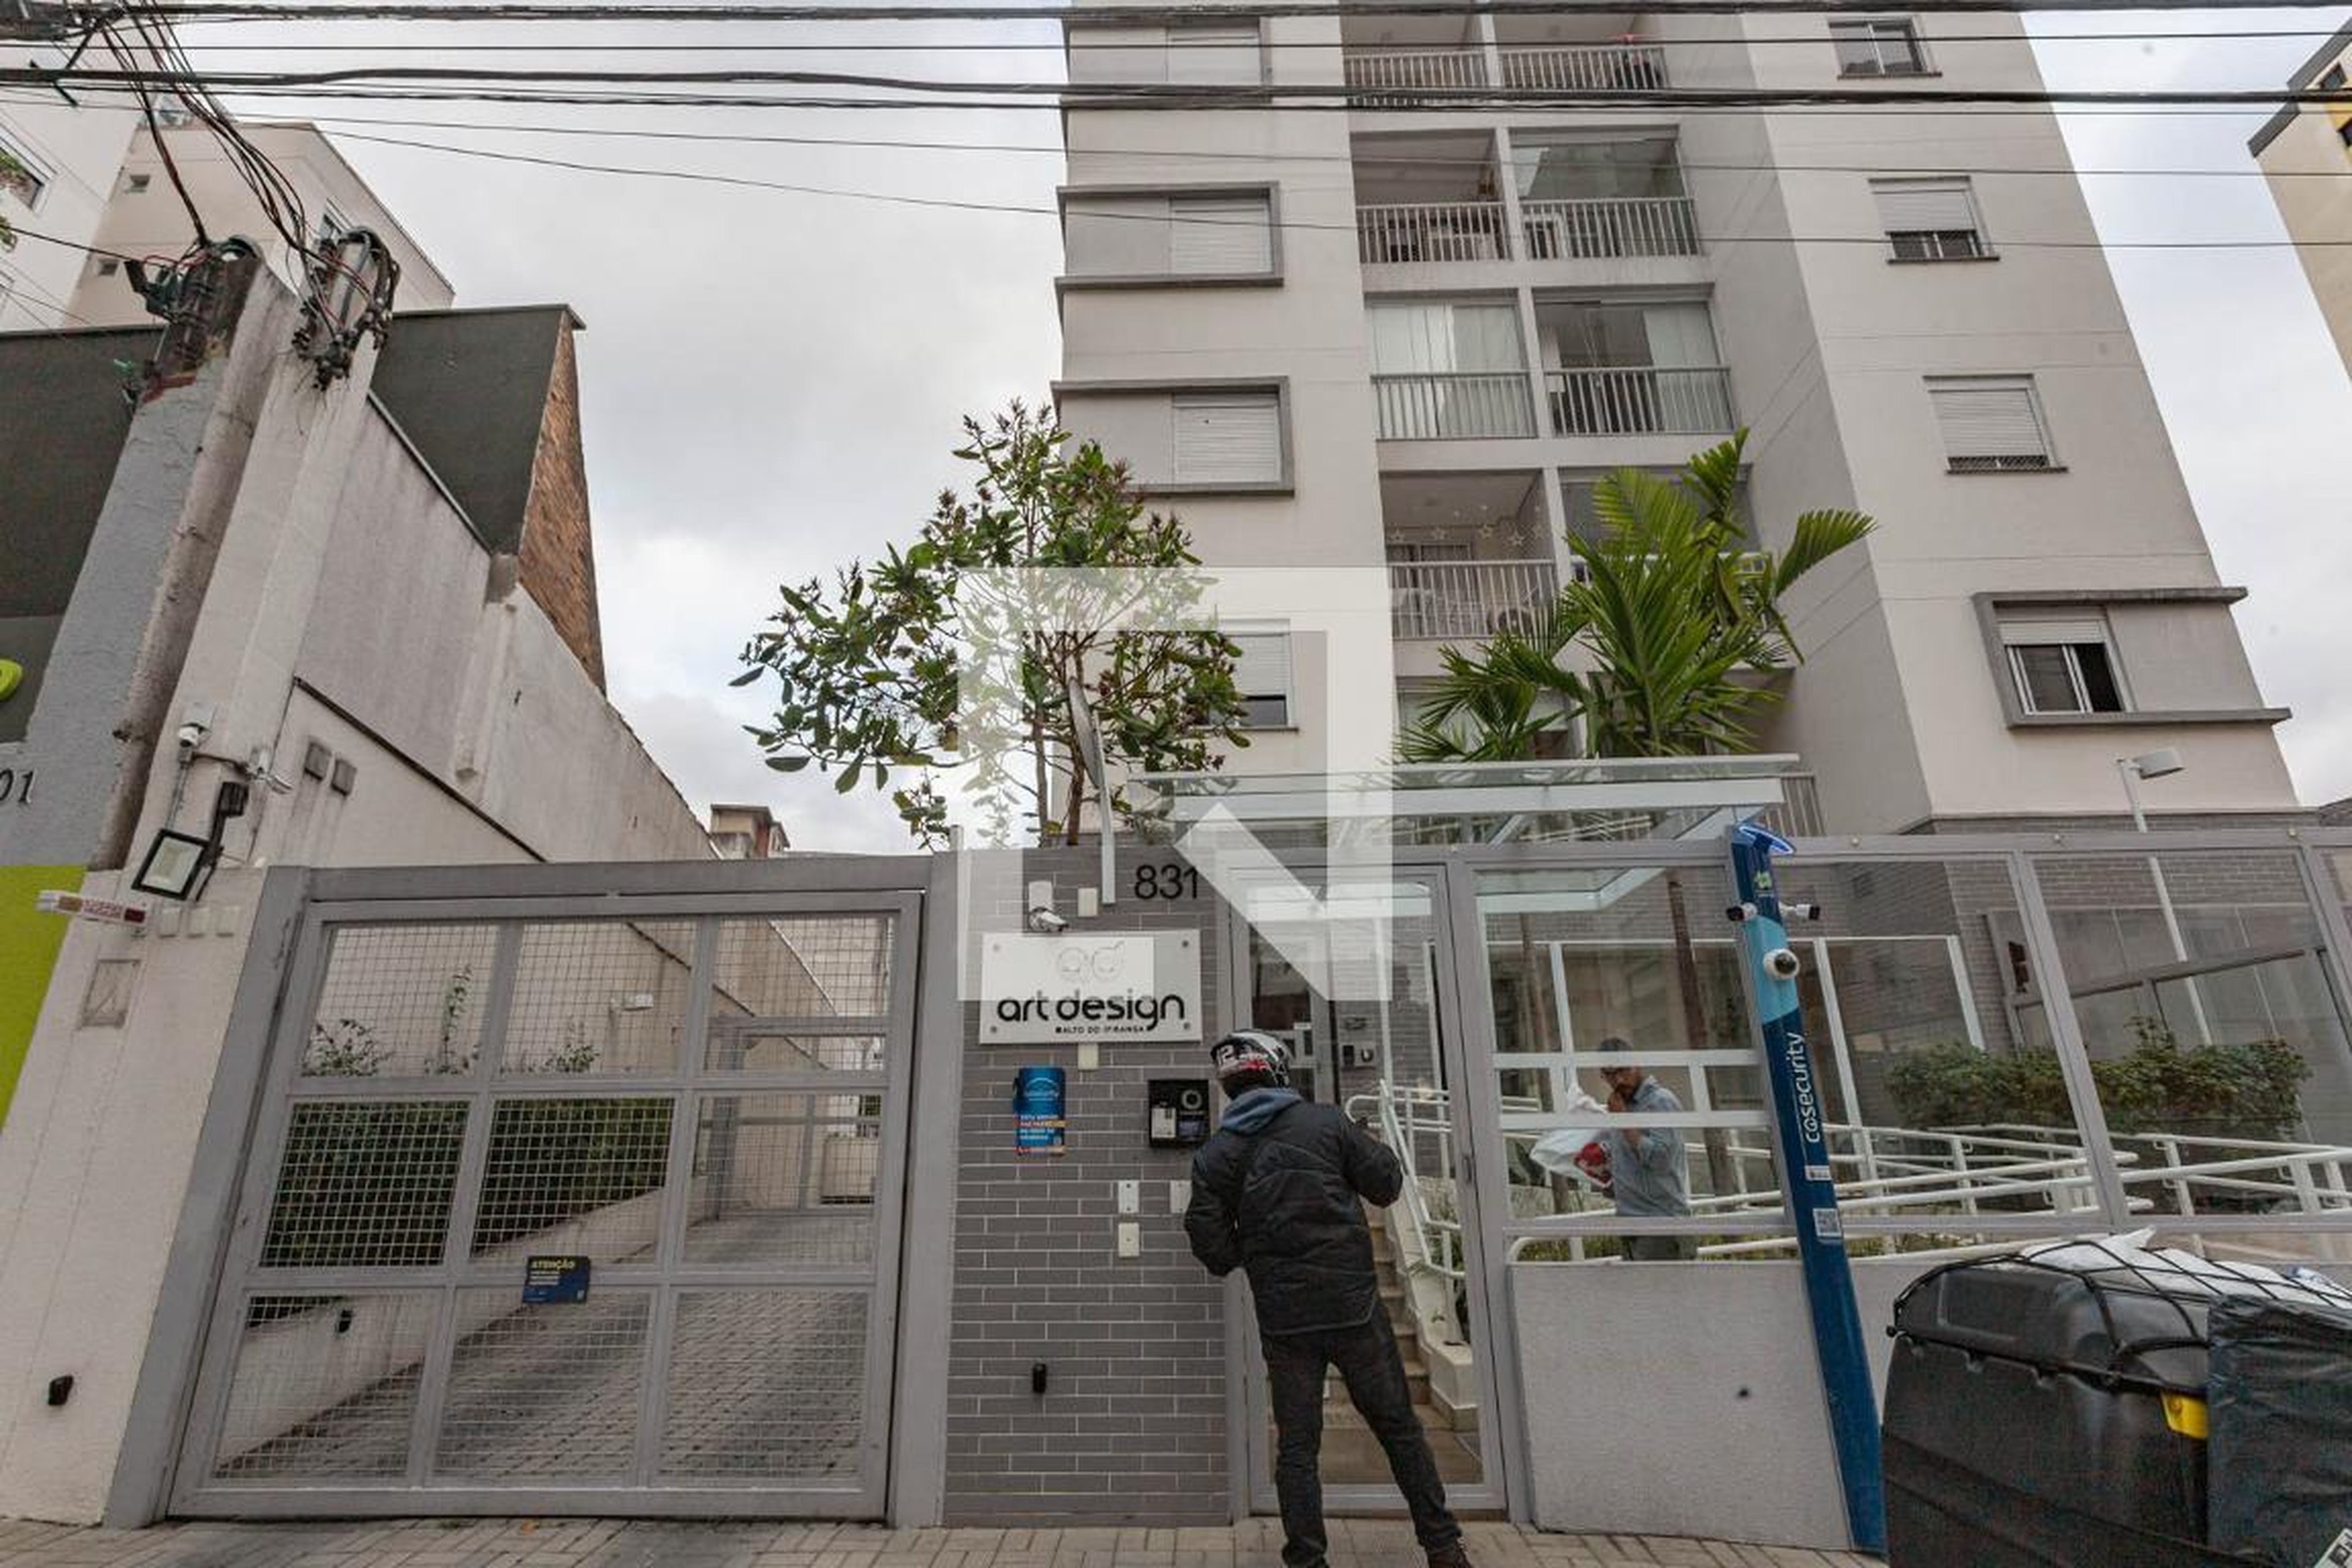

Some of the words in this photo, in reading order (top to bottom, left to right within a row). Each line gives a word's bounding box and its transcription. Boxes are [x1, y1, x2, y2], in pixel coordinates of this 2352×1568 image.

[1134, 864, 1197, 900] 831
[997, 990, 1049, 1022] art
[1055, 988, 1185, 1031] design
